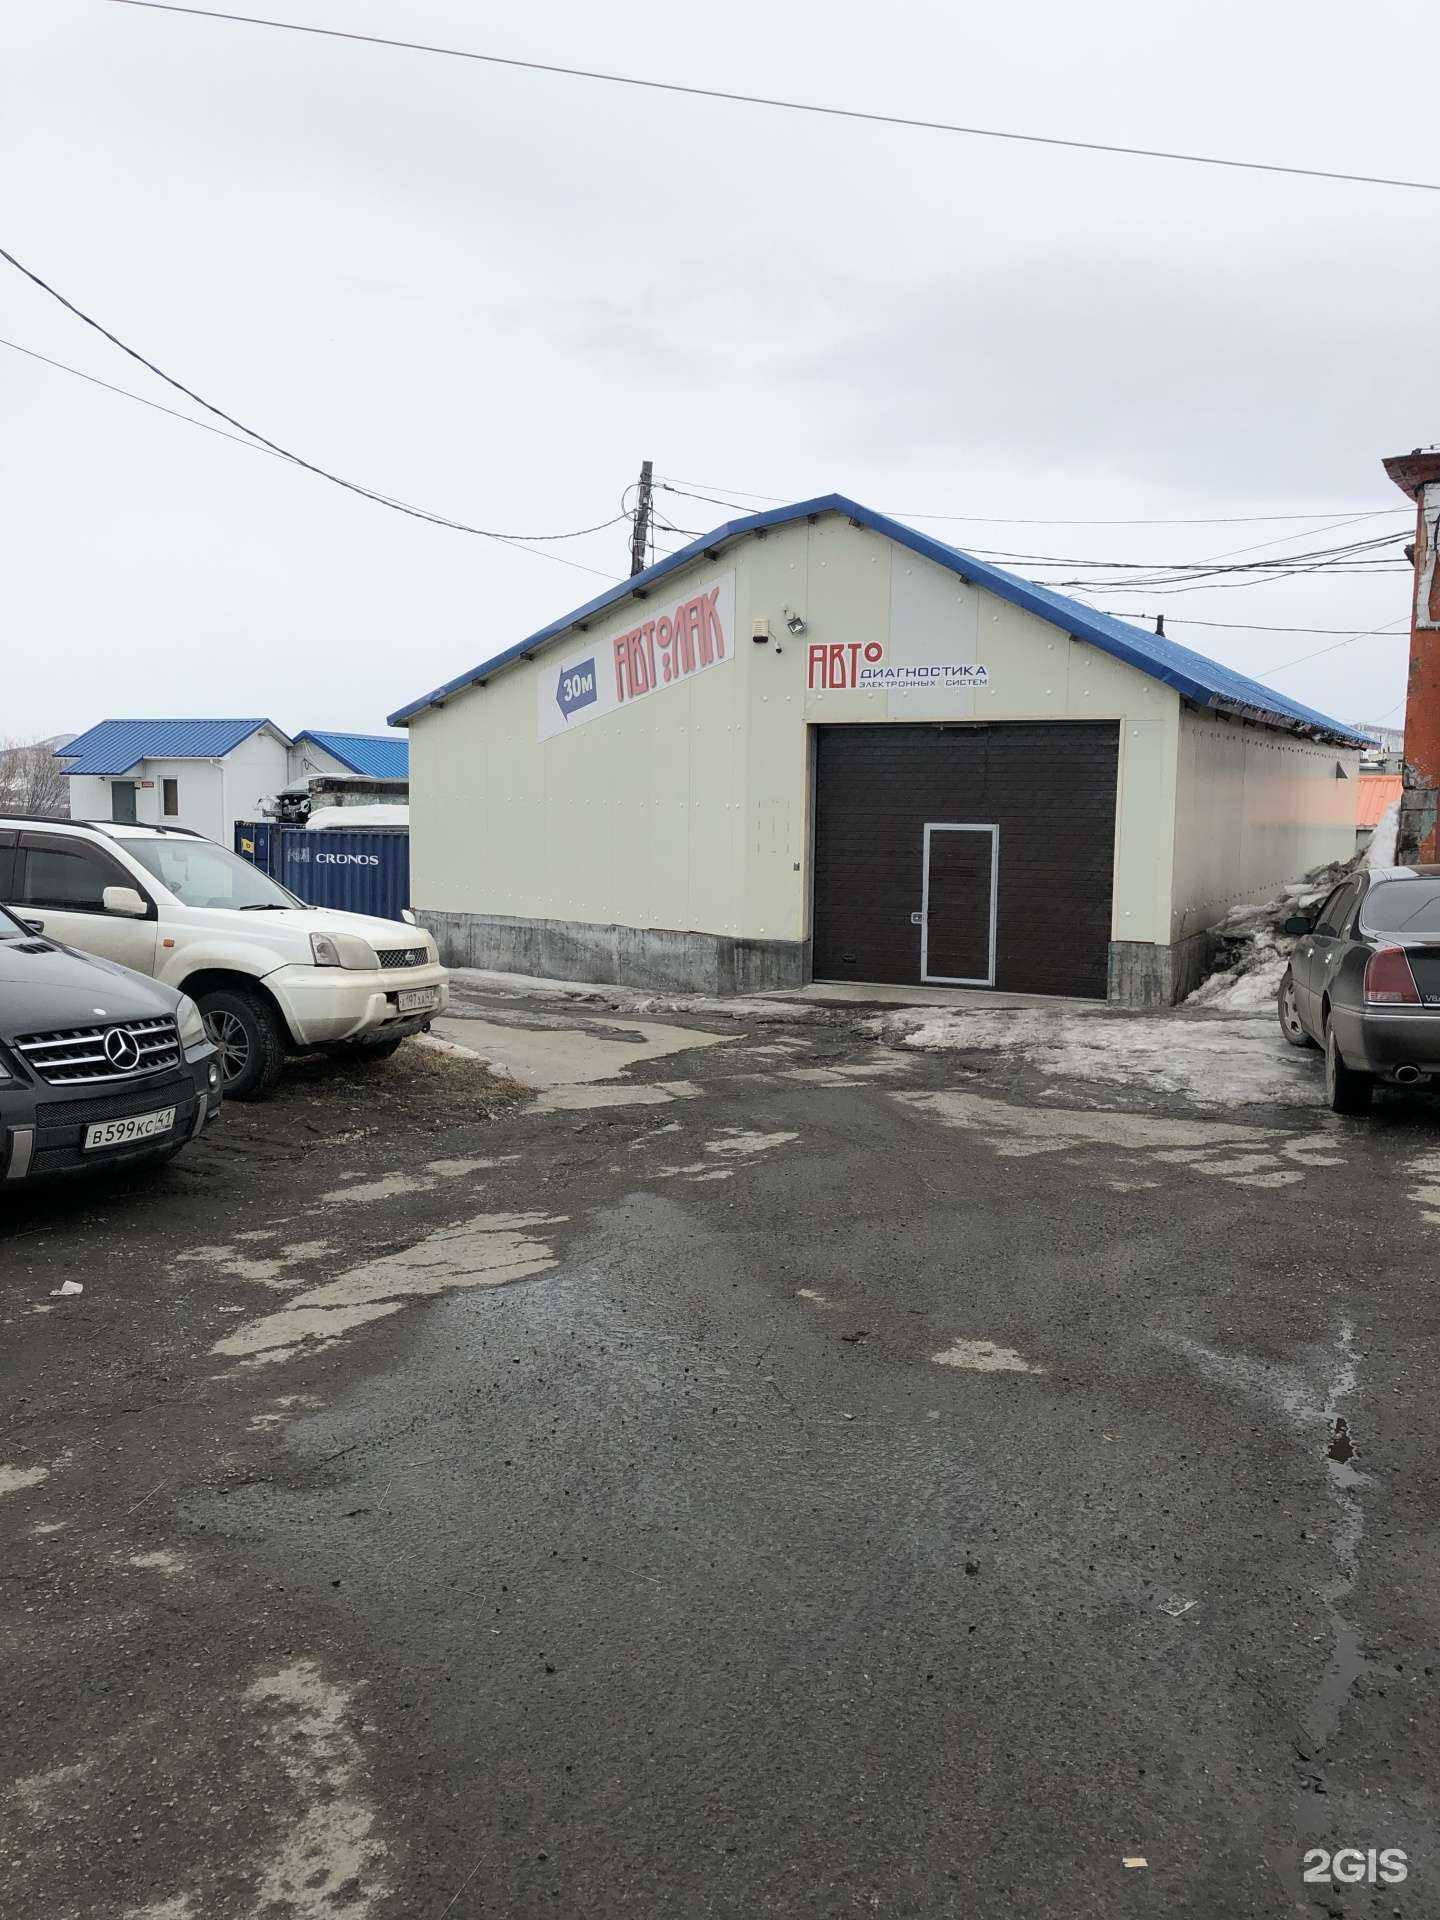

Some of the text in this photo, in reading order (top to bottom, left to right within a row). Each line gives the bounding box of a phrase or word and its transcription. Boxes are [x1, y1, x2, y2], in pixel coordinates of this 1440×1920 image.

[808, 641, 883, 689] АВТО
[860, 665, 988, 679] ДИАГНОСТИКА
[859, 678, 988, 689] ЭЛЕКТРОННЫХ СИСТЕМ
[316, 853, 379, 866] CRONOS
